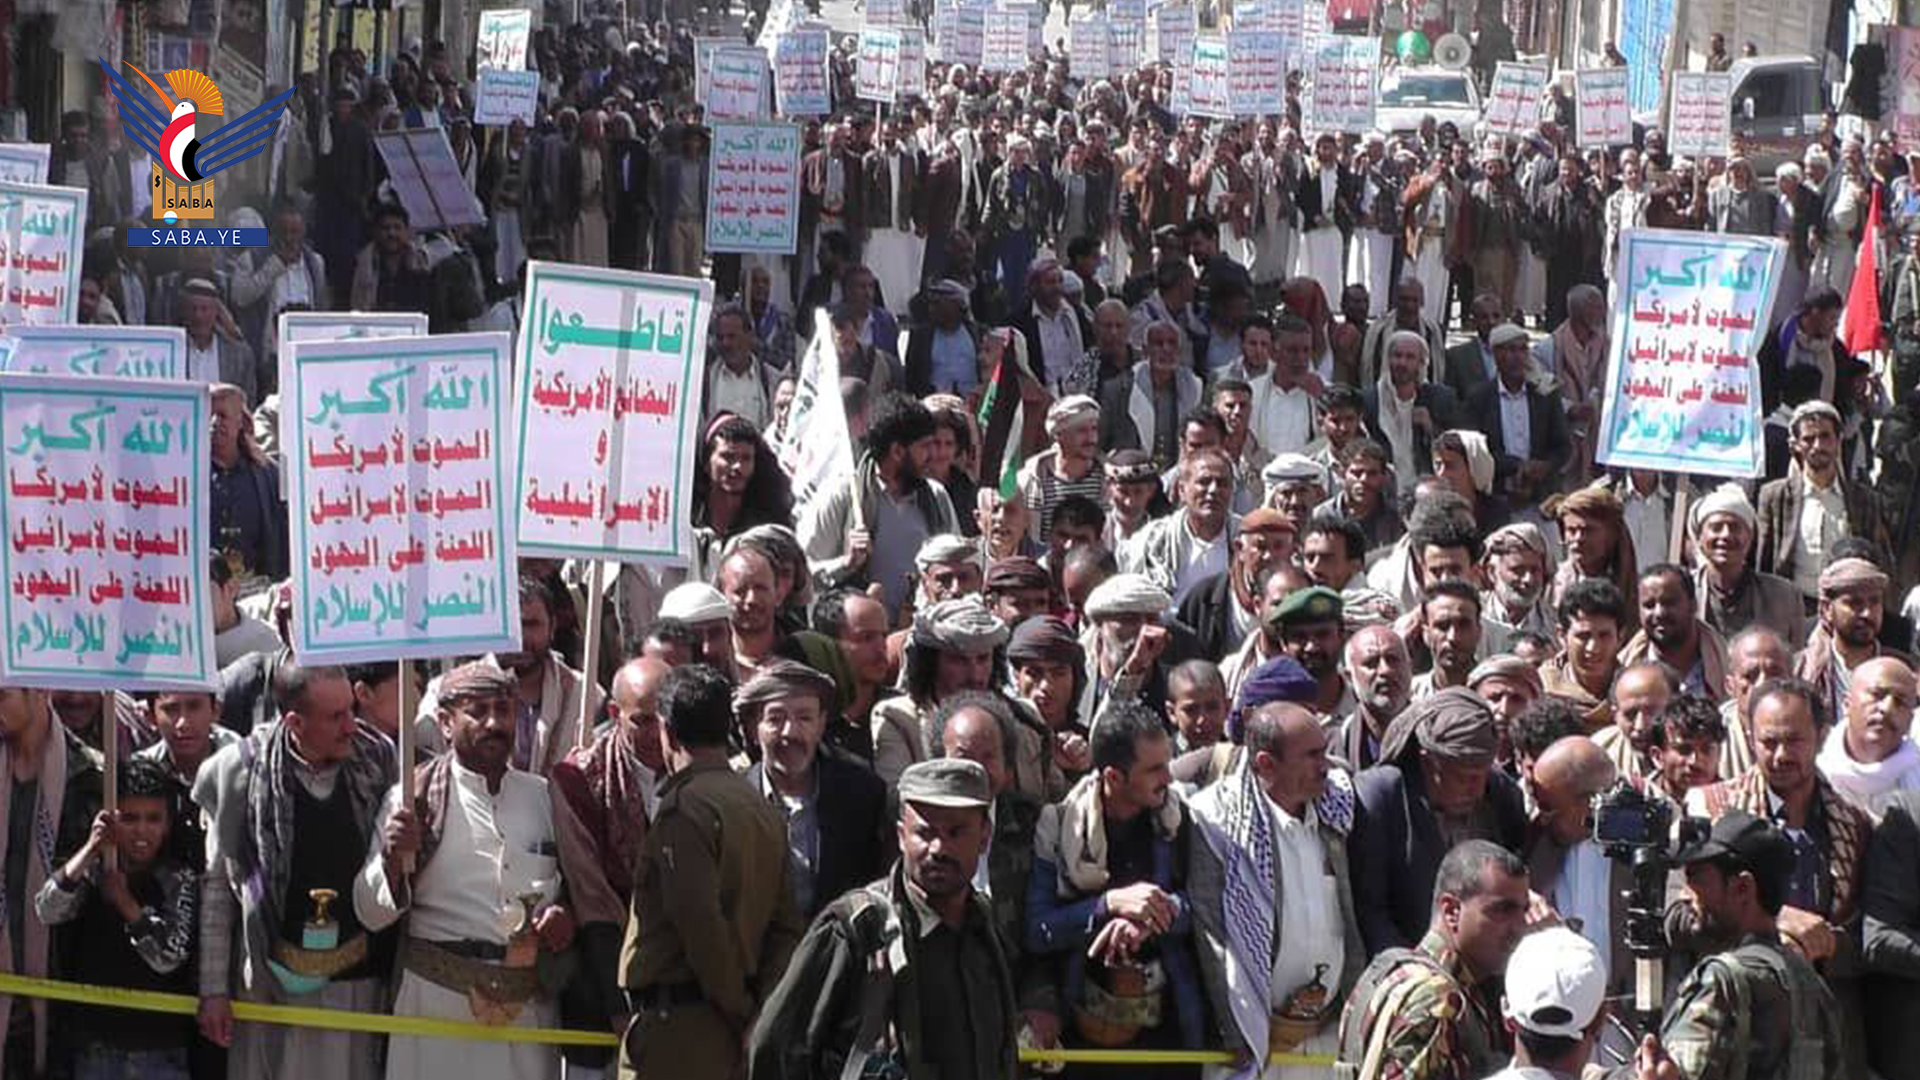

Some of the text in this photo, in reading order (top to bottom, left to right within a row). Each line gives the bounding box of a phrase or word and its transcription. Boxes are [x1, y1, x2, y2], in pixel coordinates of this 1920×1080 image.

[1633, 248, 1715, 297] أكبر
[306, 358, 490, 431] الله أكبر
[532, 367, 677, 424] البضائع الأمريكية
[8, 400, 188, 463] الله أكبر
[309, 425, 490, 473] الموت لأمريكا
[594, 428, 608, 466] و
[10, 464, 188, 511] الموت لأمريكا
[311, 480, 492, 525] الموت لإسرائيل
[525, 477, 670, 533] الإسرائيلية
[13, 514, 188, 560] الموت لإسرائيل
[311, 529, 494, 576] اللعنة على اليهود
[13, 567, 190, 606] اللعنة على اليهود
[314, 571, 497, 637] النصر للإسلام
[17, 611, 193, 666] النصر للإسلام
